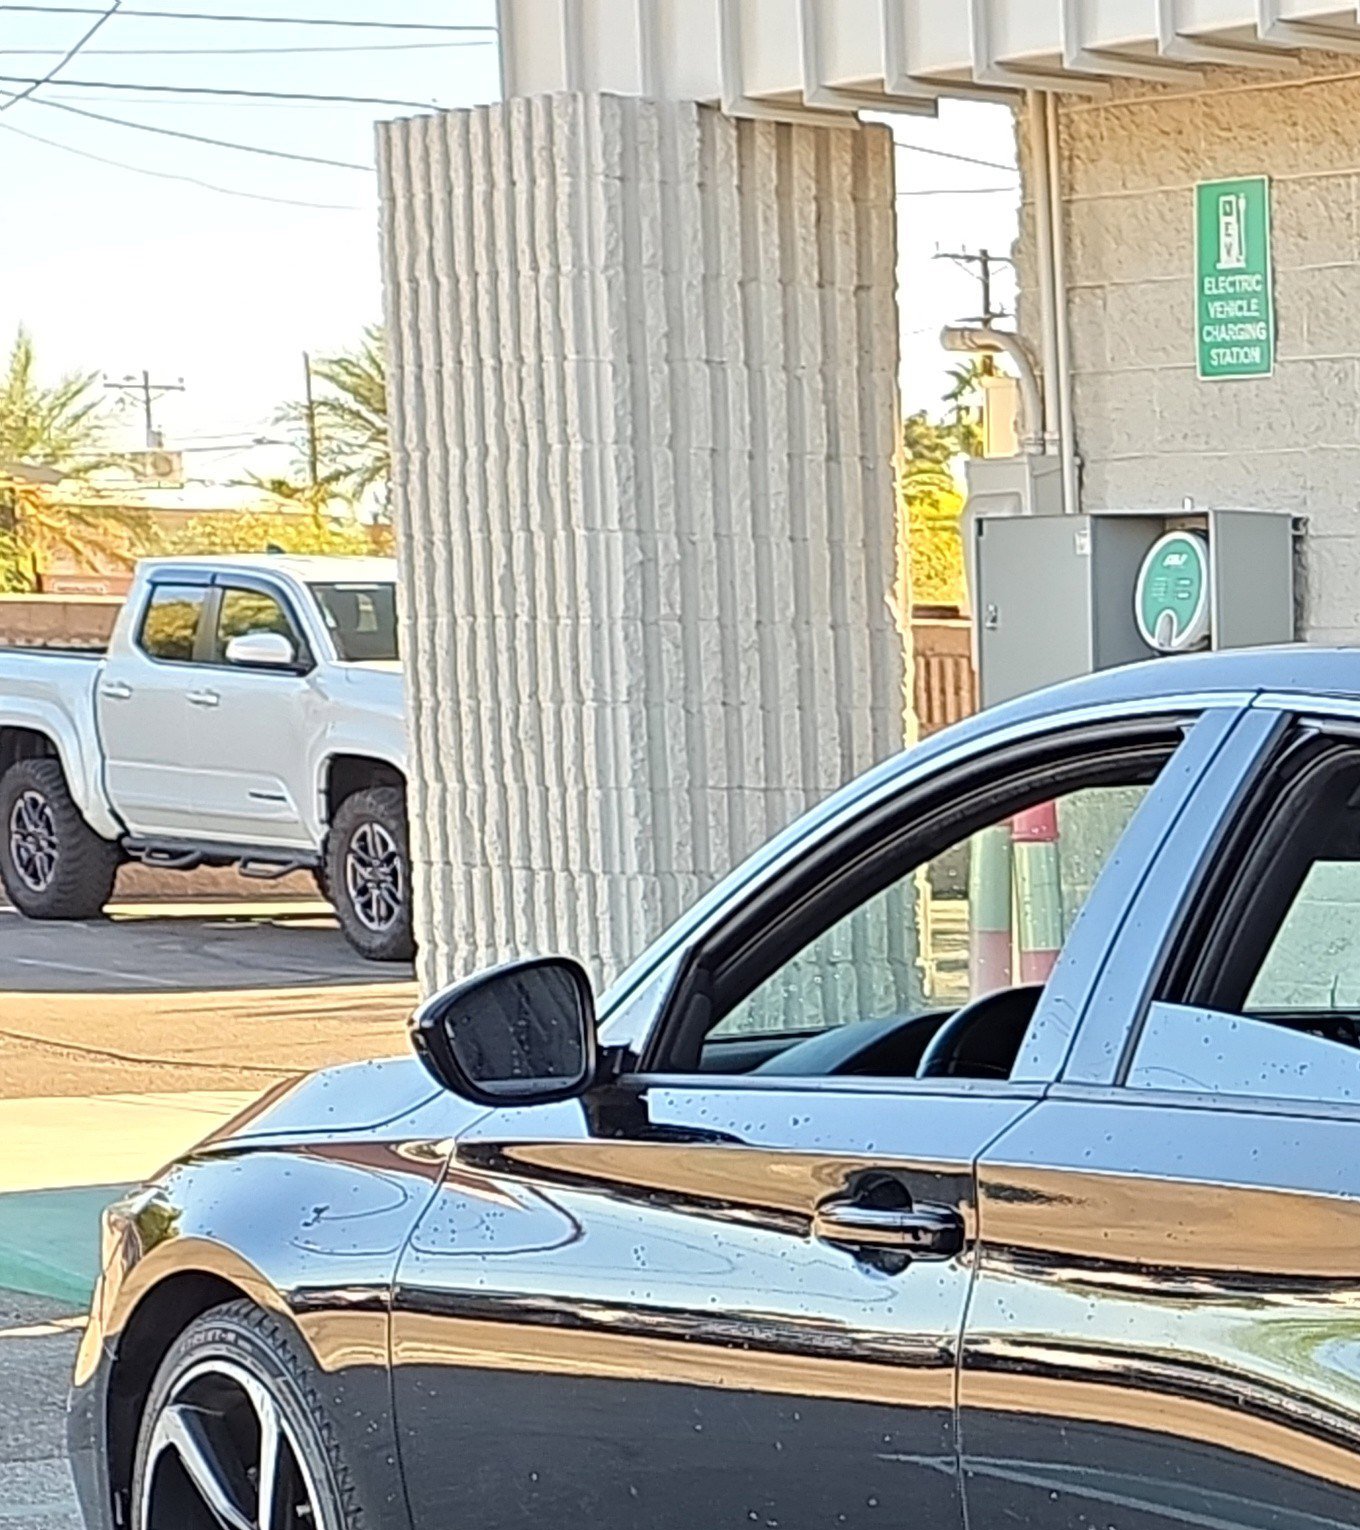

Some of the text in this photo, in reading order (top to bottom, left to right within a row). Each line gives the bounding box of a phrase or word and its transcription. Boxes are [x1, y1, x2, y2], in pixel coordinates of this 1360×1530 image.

[1203, 274, 1263, 295] ELECTRIC
[1208, 298, 1260, 318] VEHICLE
[1202, 322, 1267, 342] CHARGING
[1209, 346, 1261, 366] STATION
